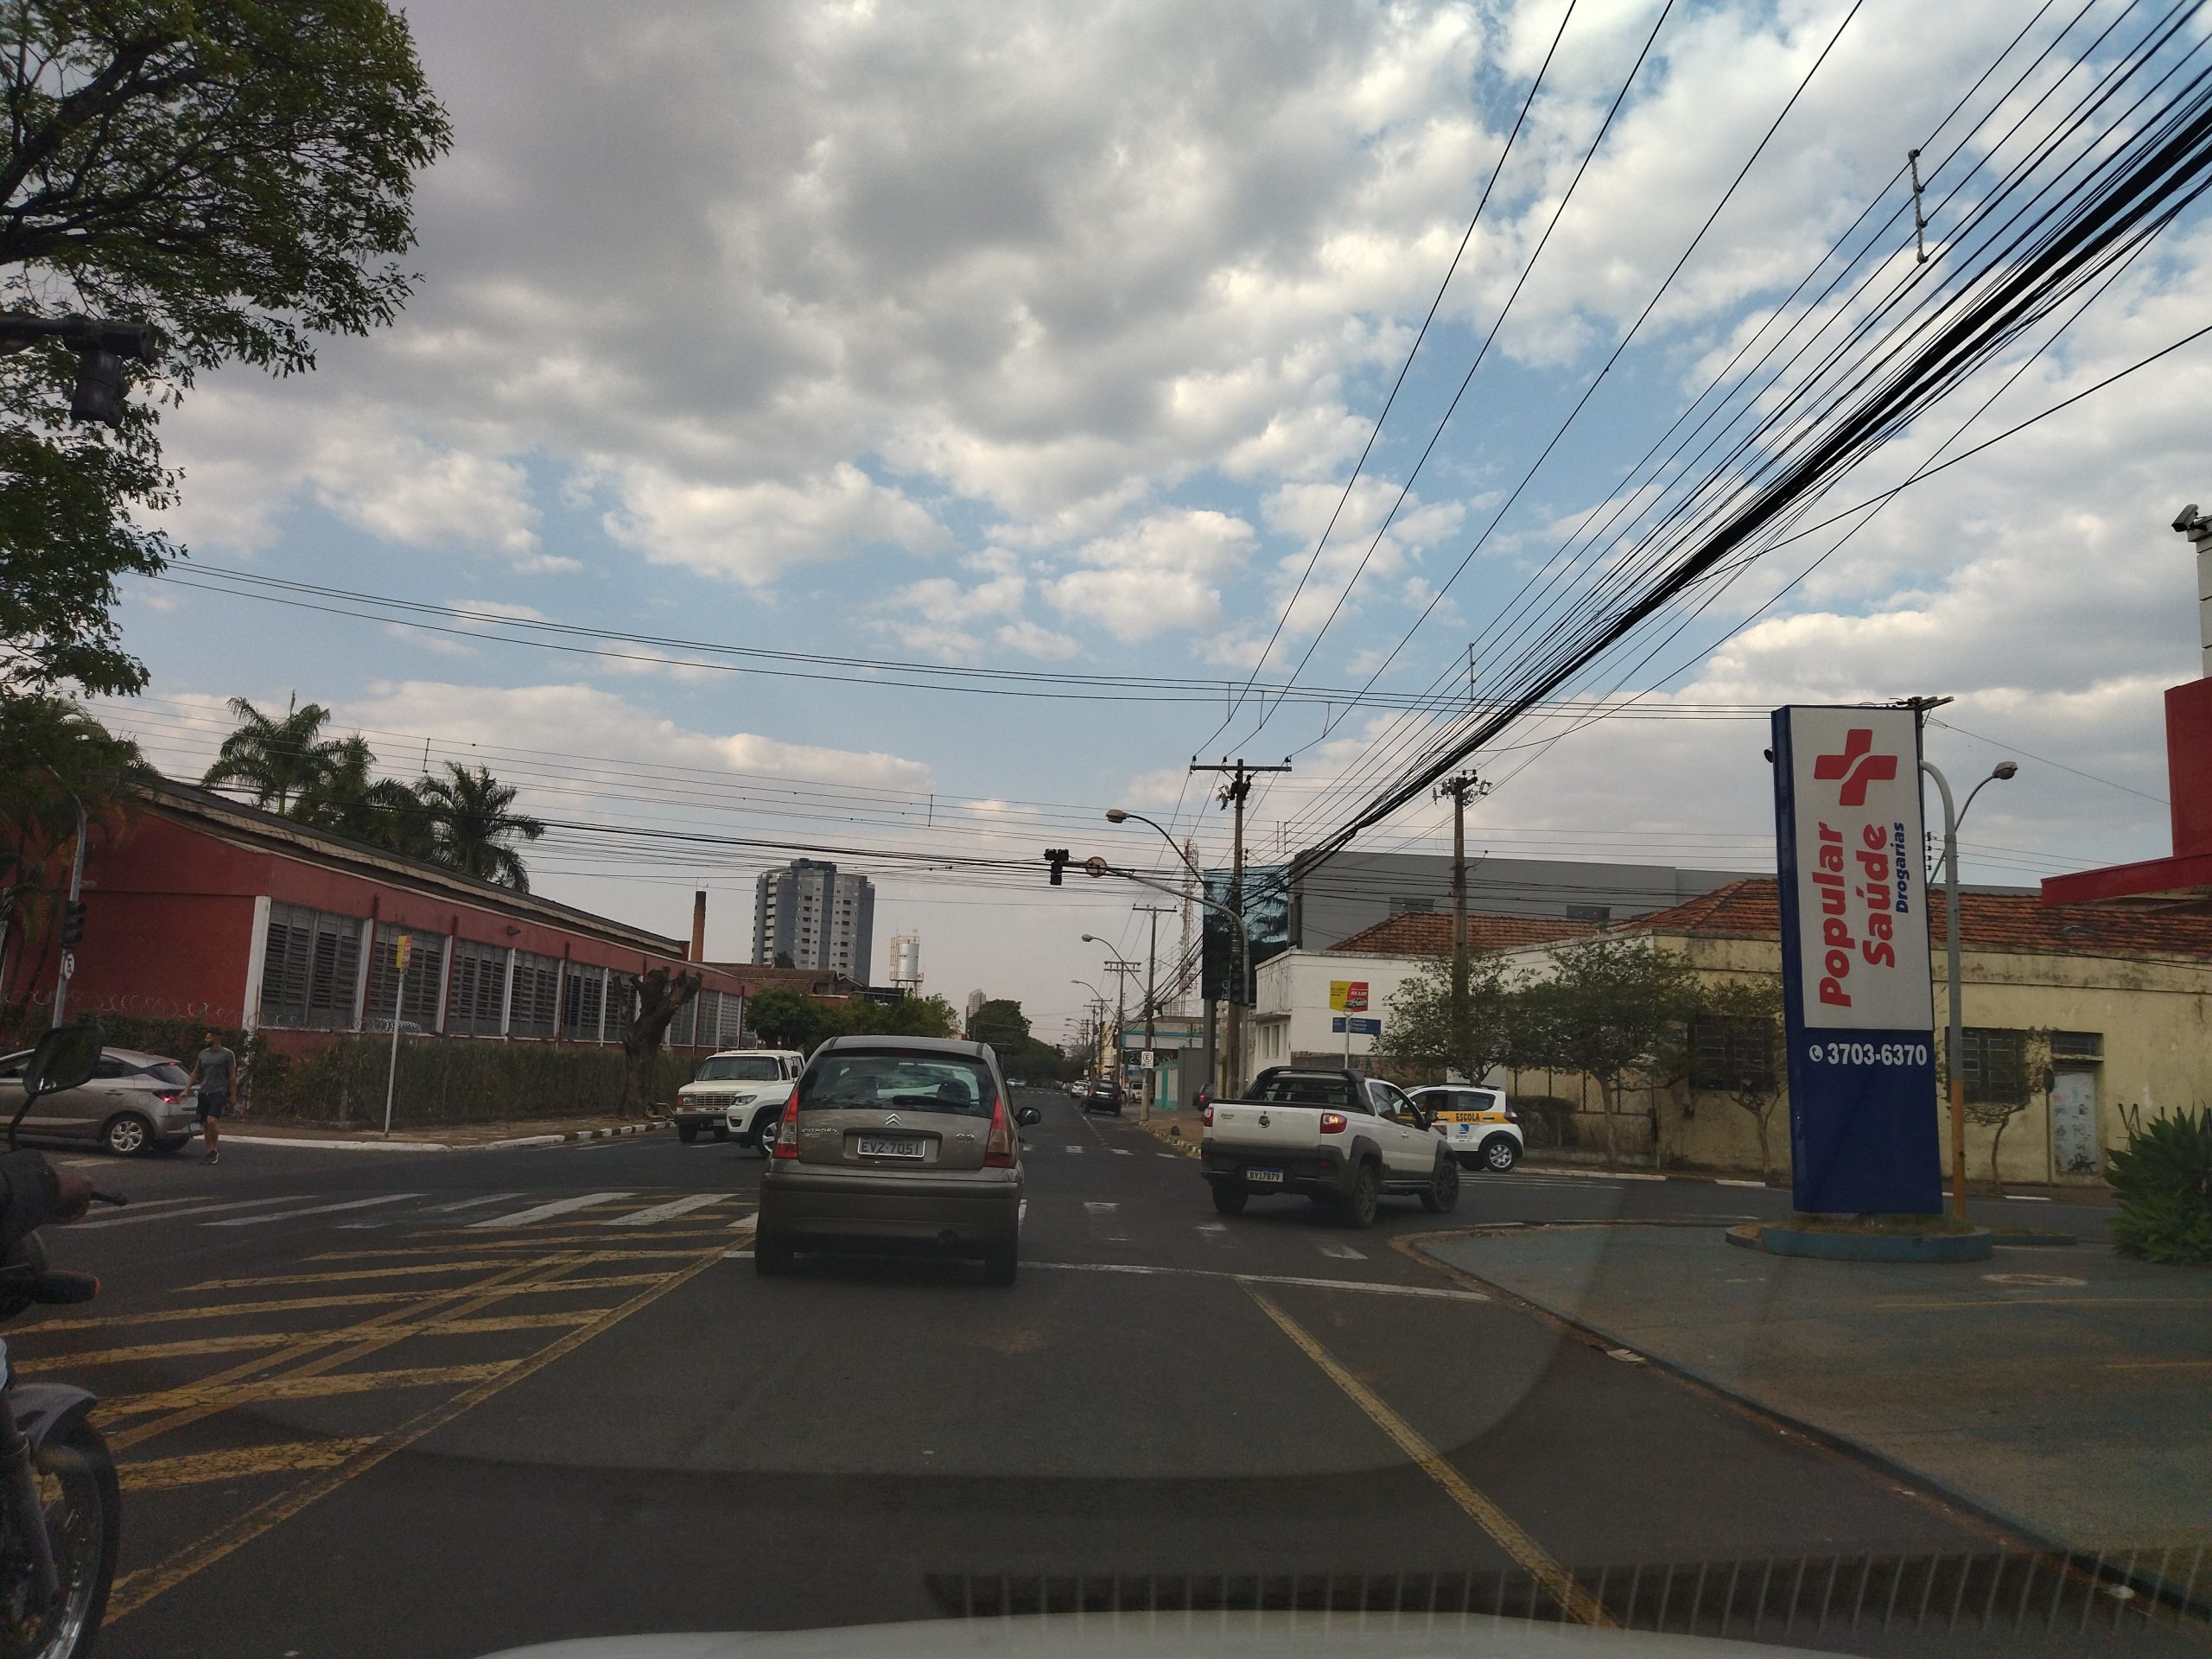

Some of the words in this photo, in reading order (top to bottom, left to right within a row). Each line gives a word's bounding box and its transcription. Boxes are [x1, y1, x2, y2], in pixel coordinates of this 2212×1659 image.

[1856, 823, 1895, 968] Saúde
[1891, 822, 1910, 913] Drogarias
[1813, 822, 1855, 1007] Popular
[1827, 1042, 1928, 1066] 3703-6370
[1456, 1112, 1480, 1122] ESCOLA
